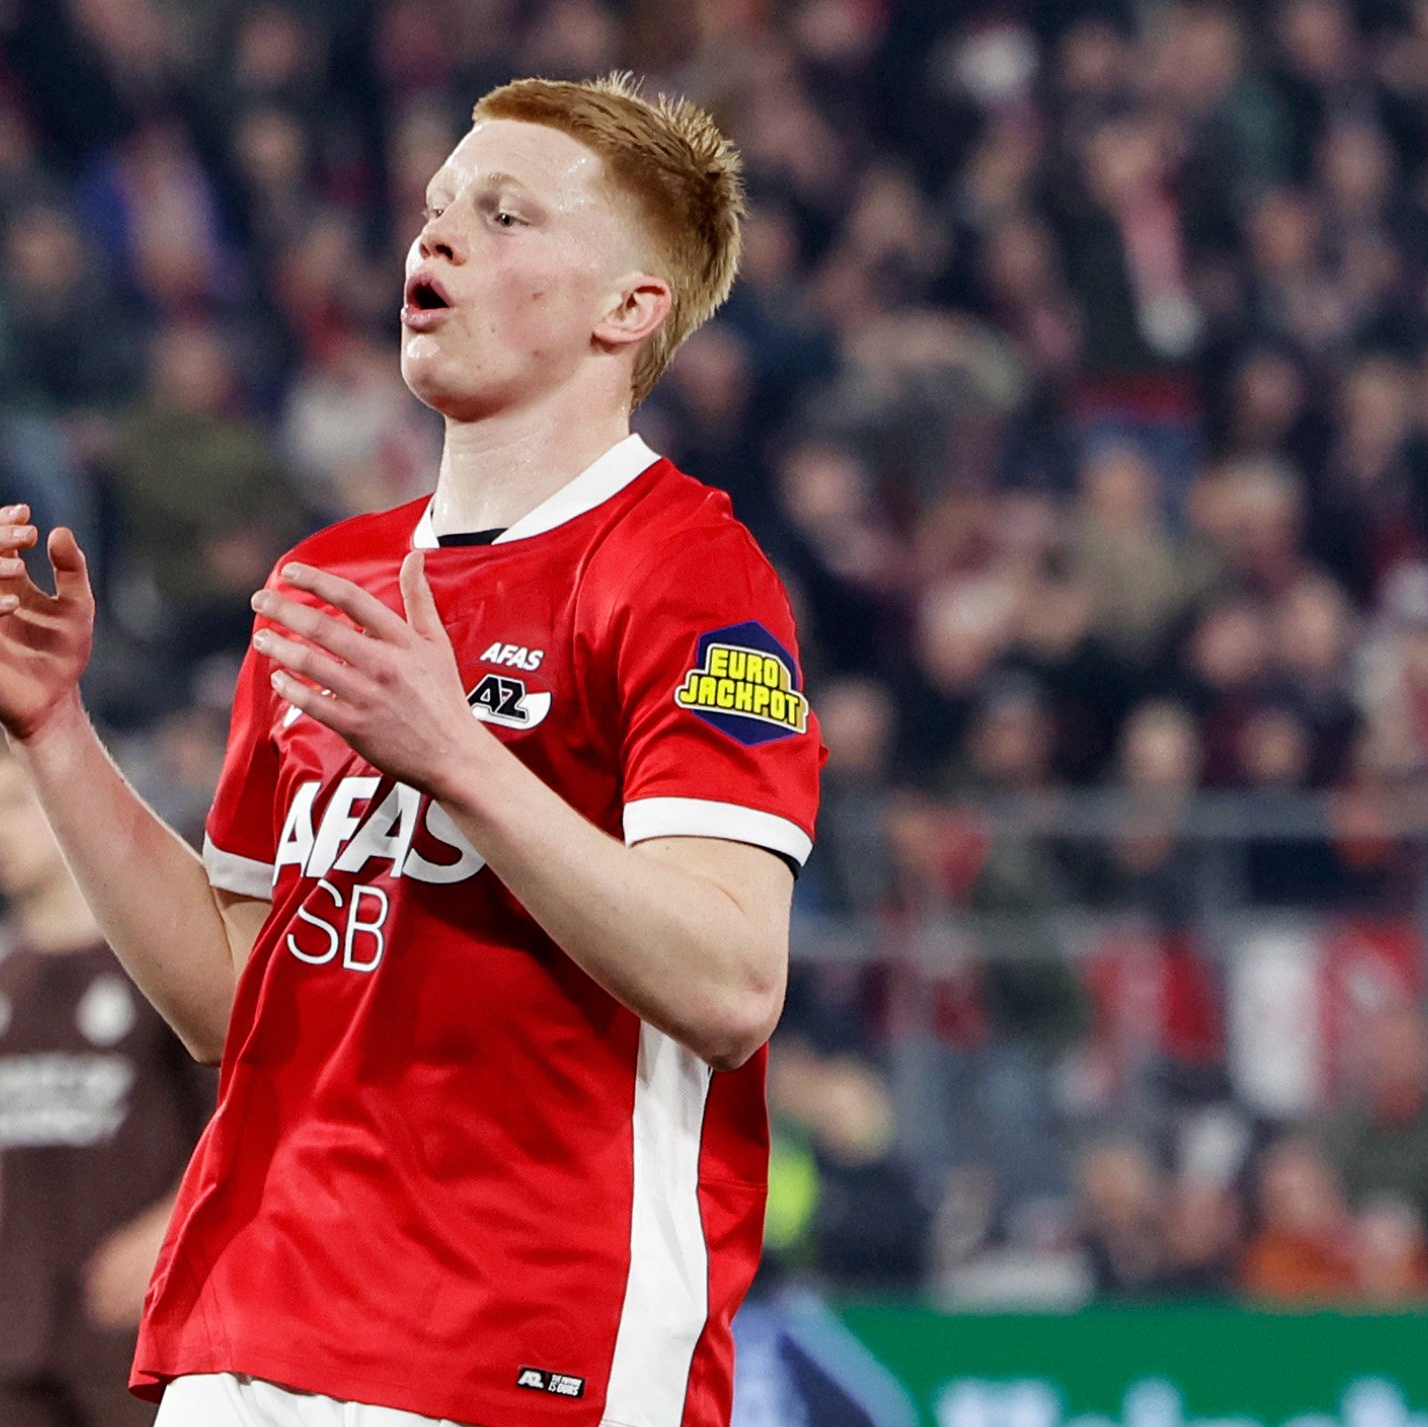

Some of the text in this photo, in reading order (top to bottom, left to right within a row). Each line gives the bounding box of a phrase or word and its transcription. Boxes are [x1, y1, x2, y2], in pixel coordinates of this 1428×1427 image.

[480, 642, 545, 671] AFAS
[710, 648, 779, 689] EURO
[467, 674, 529, 722] AZ
[679, 674, 799, 726] JACKPOT
[287, 879, 389, 972] SB
